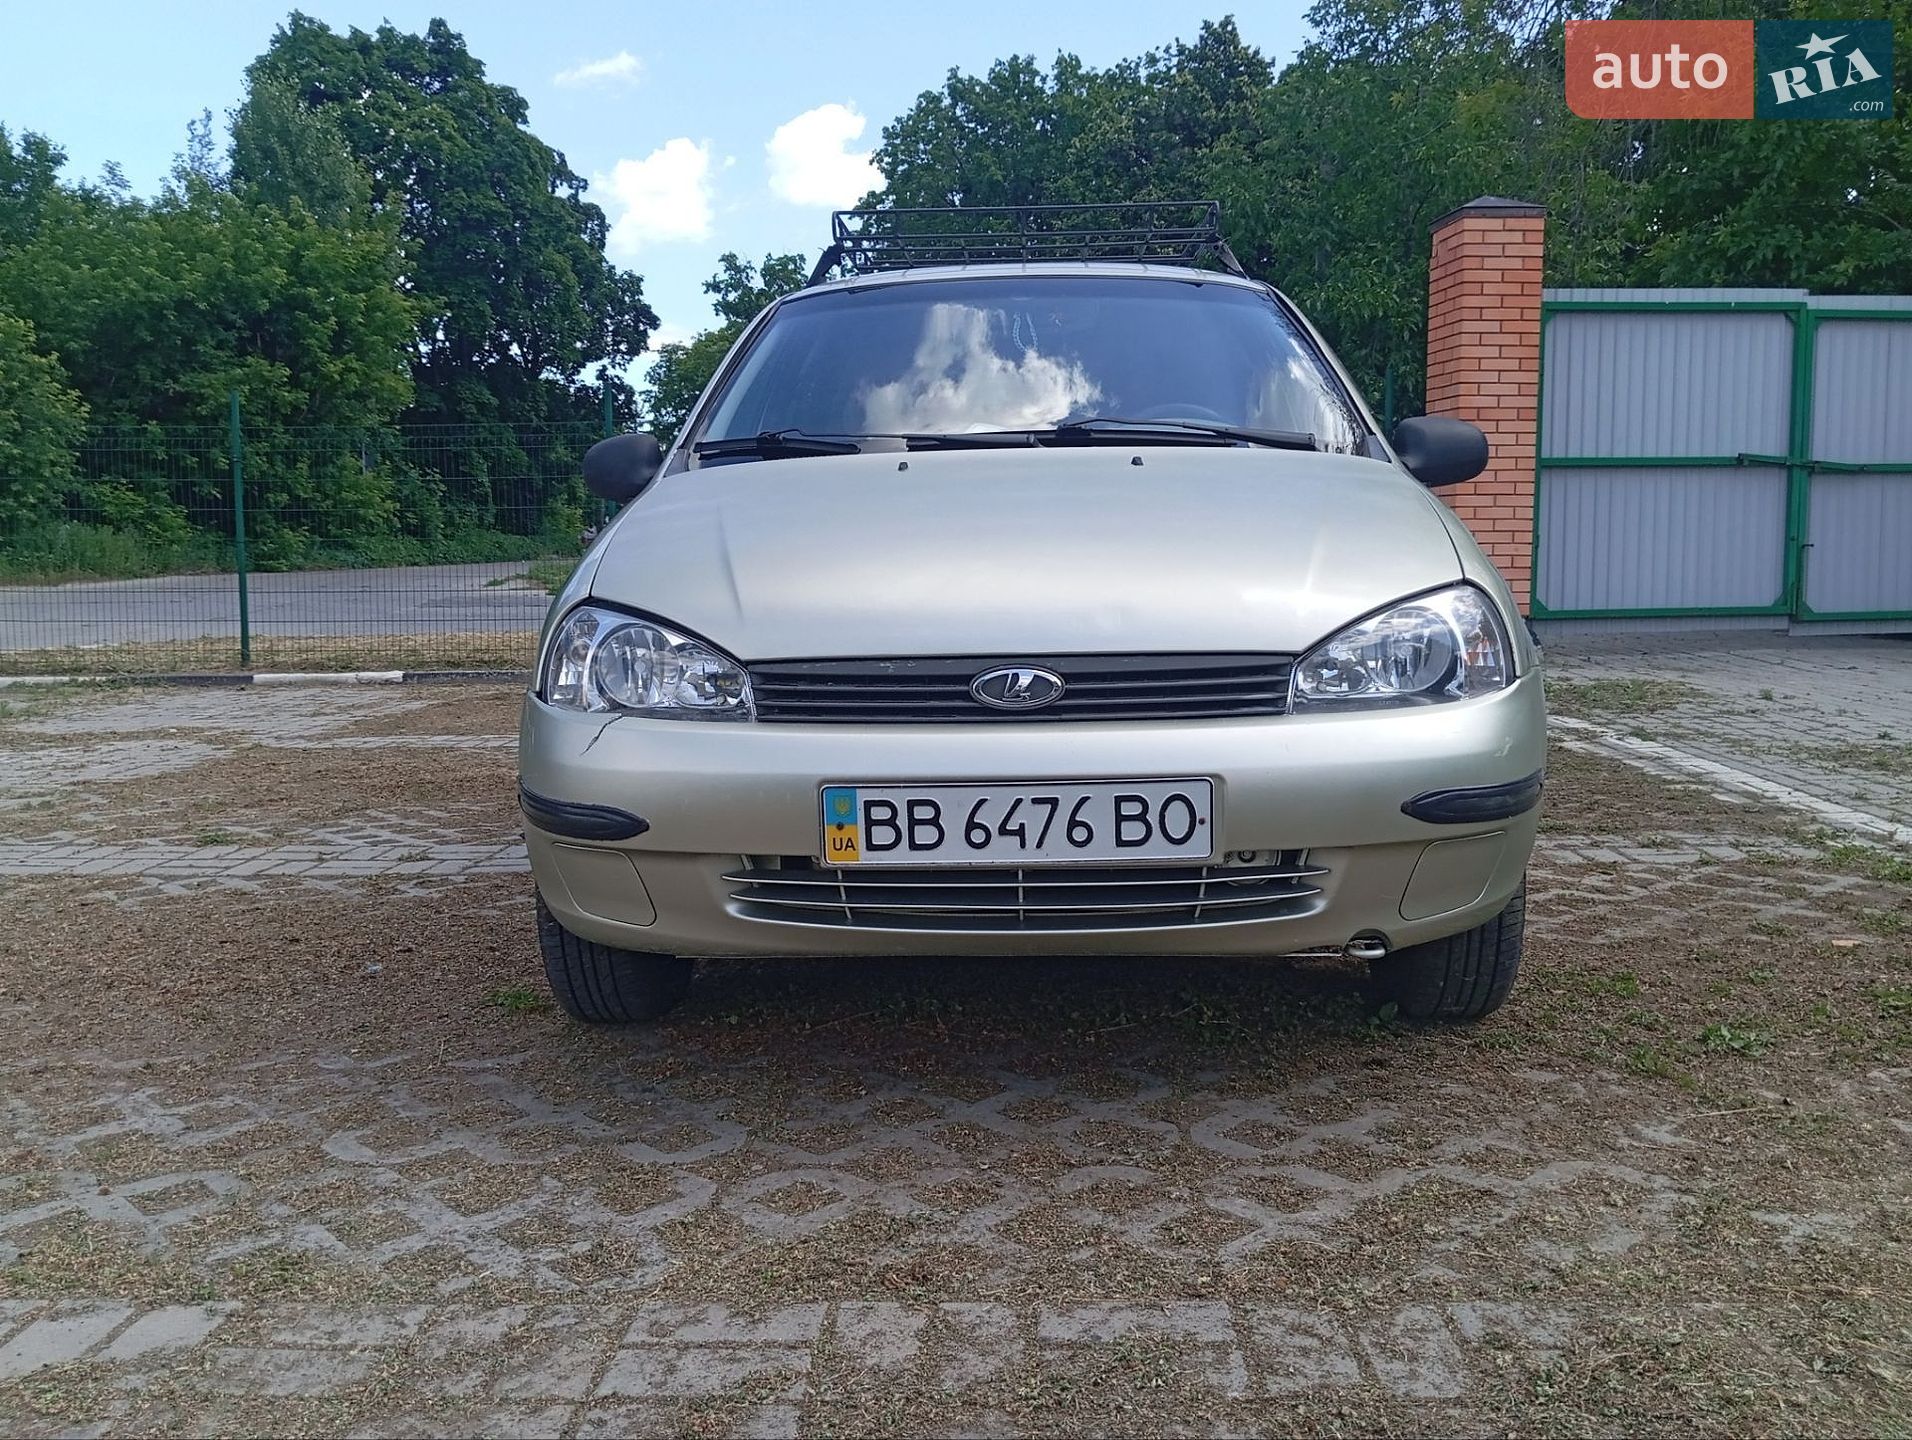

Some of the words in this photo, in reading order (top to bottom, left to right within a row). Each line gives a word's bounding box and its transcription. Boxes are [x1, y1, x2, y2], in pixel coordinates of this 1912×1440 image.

[863, 799, 946, 852] BB
[964, 796, 1095, 850] 6476
[1113, 793, 1197, 847] BO
[832, 837, 856, 852] UA
